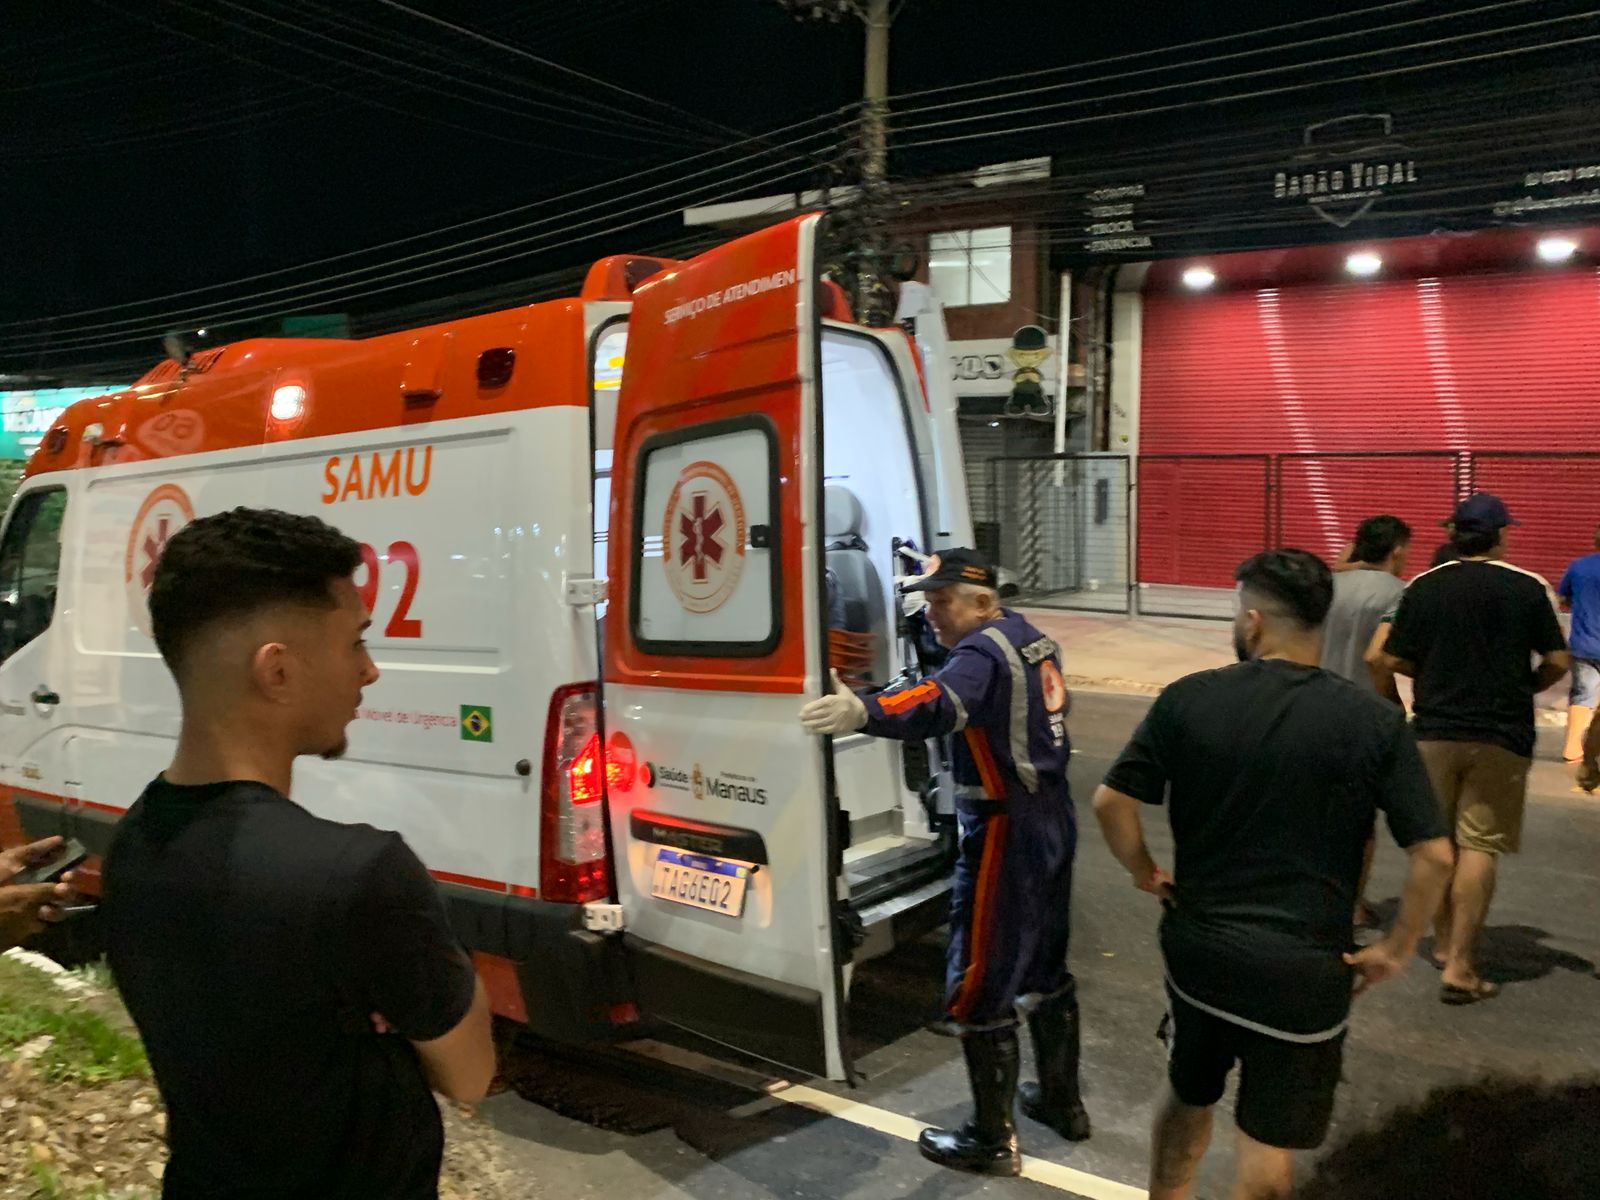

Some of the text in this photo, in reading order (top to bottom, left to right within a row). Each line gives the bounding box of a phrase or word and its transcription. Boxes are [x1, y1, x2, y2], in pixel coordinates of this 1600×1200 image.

[1351, 160, 1418, 189] VIDAL
[706, 290, 723, 310] DE
[320, 445, 433, 505] SAMU
[659, 765, 690, 784] Saúde
[705, 775, 768, 806] Manaus
